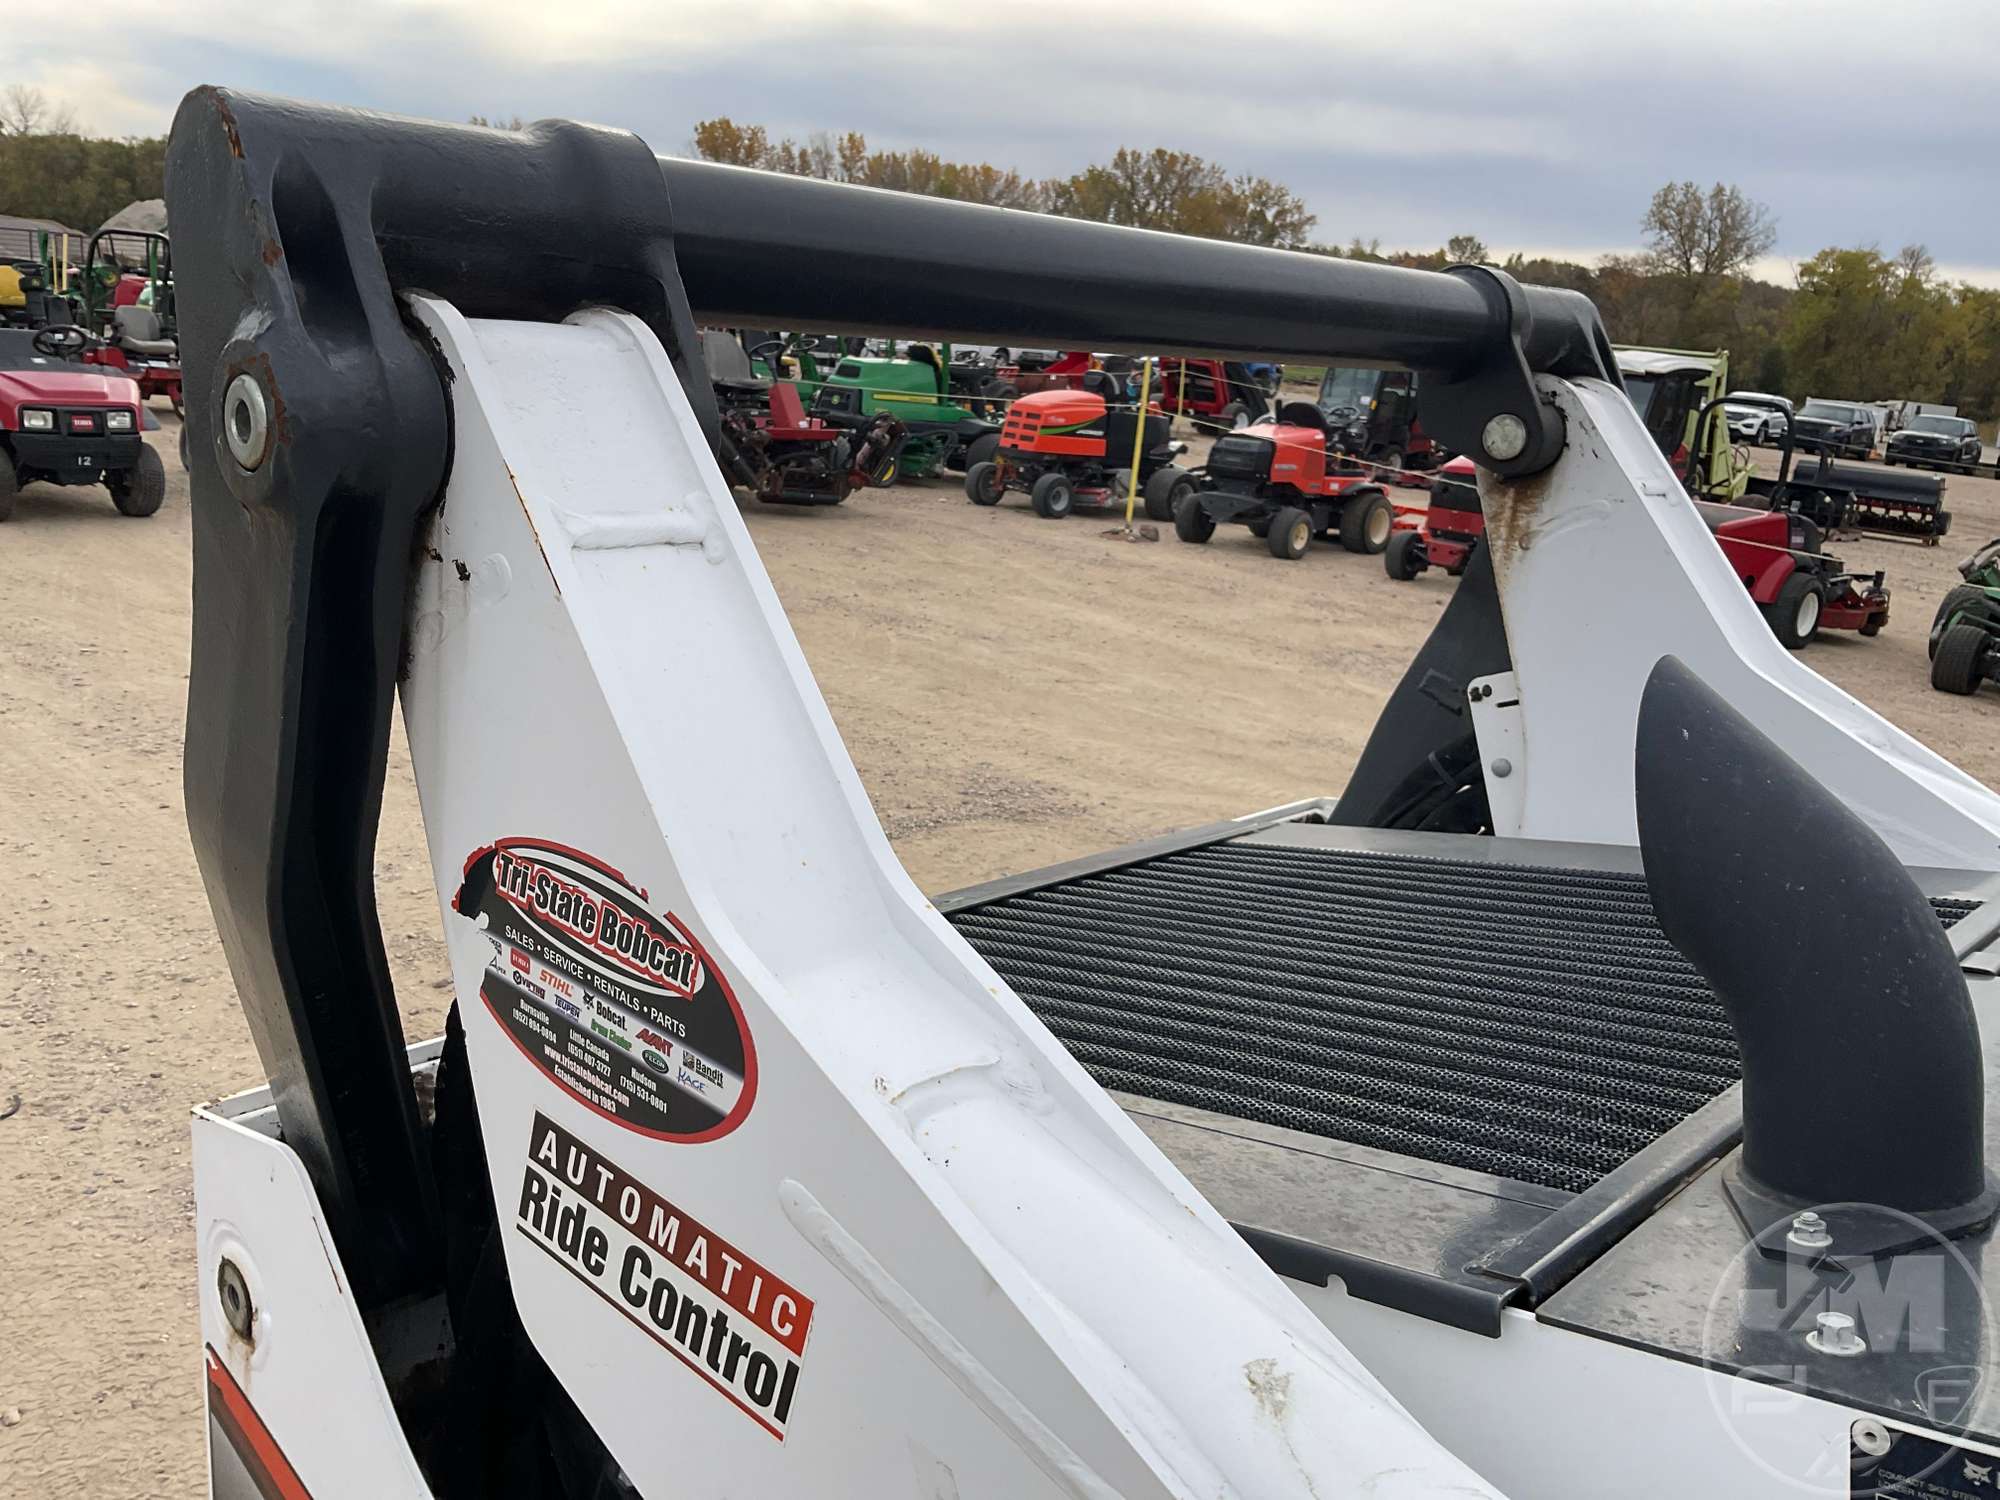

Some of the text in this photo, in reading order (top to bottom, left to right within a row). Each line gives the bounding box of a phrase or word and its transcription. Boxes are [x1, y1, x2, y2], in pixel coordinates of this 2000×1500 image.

[78, 456, 92, 466] 12
[499, 854, 694, 988] Tri-State Bobcat
[505, 925, 535, 951] SALES
[543, 947, 584, 980] SERVICE
[594, 975, 640, 1012] RENTALS
[650, 1007, 686, 1038] PARTS
[540, 969, 572, 998] STIHL
[520, 998, 550, 1025] Burnsville
[554, 994, 580, 1018] TEUPEN
[596, 1000, 627, 1032] Bobcat
[569, 1028, 610, 1062] Little Canada
[635, 1028, 674, 1057] AVANT
[543, 1044, 630, 1108] www.tristatebobcat.com
[631, 1067, 657, 1092] Hudson
[695, 1058, 724, 1084] Bandit
[554, 1064, 617, 1113] Established in 1983
[620, 1075, 668, 1114] (715) 531-0801
[537, 1130, 798, 1338] AUTOMATIC
[518, 1167, 801, 1425] Ride Control
